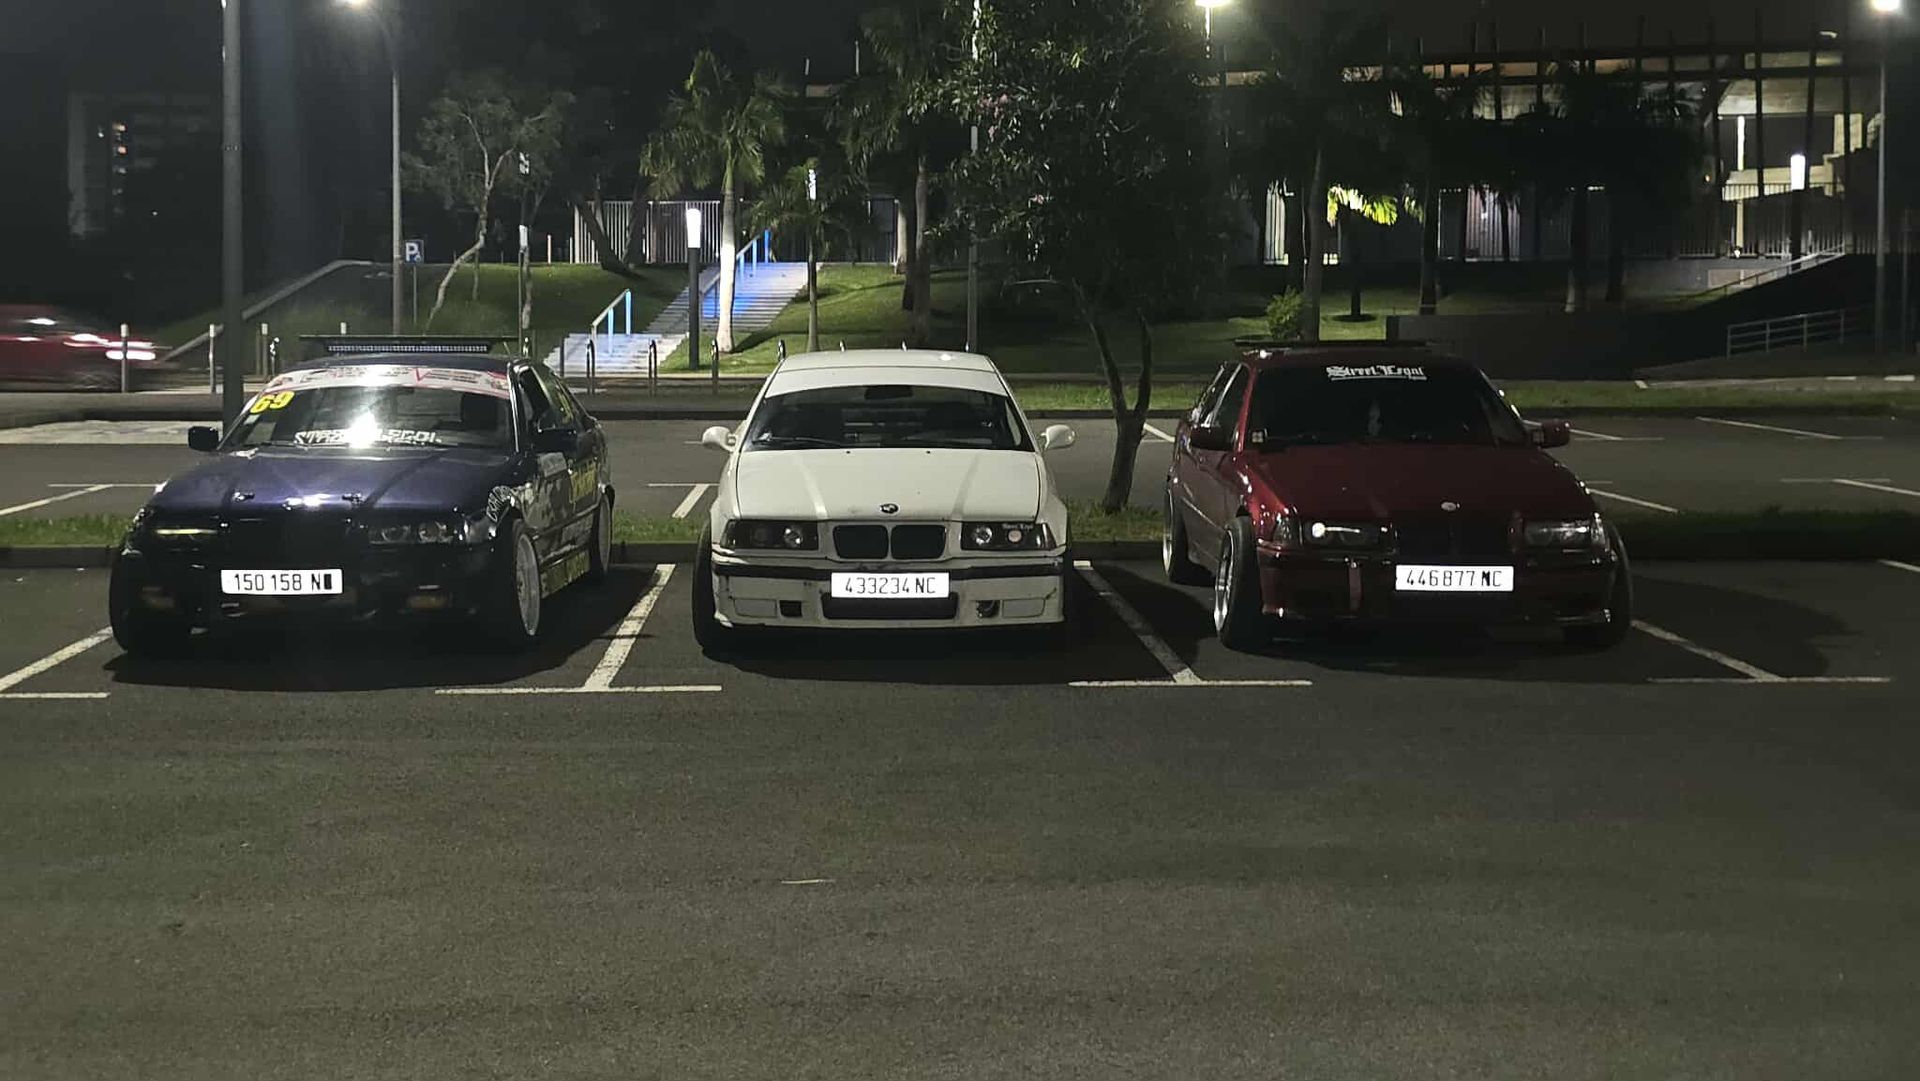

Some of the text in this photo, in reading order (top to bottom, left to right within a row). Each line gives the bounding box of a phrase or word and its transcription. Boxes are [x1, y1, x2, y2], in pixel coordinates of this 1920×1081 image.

[250, 391, 295, 413] 69
[234, 573, 264, 591] 150
[271, 573, 302, 591] 158
[845, 577, 936, 594] 433234 NC
[1406, 569, 1502, 586] 446877 NC
